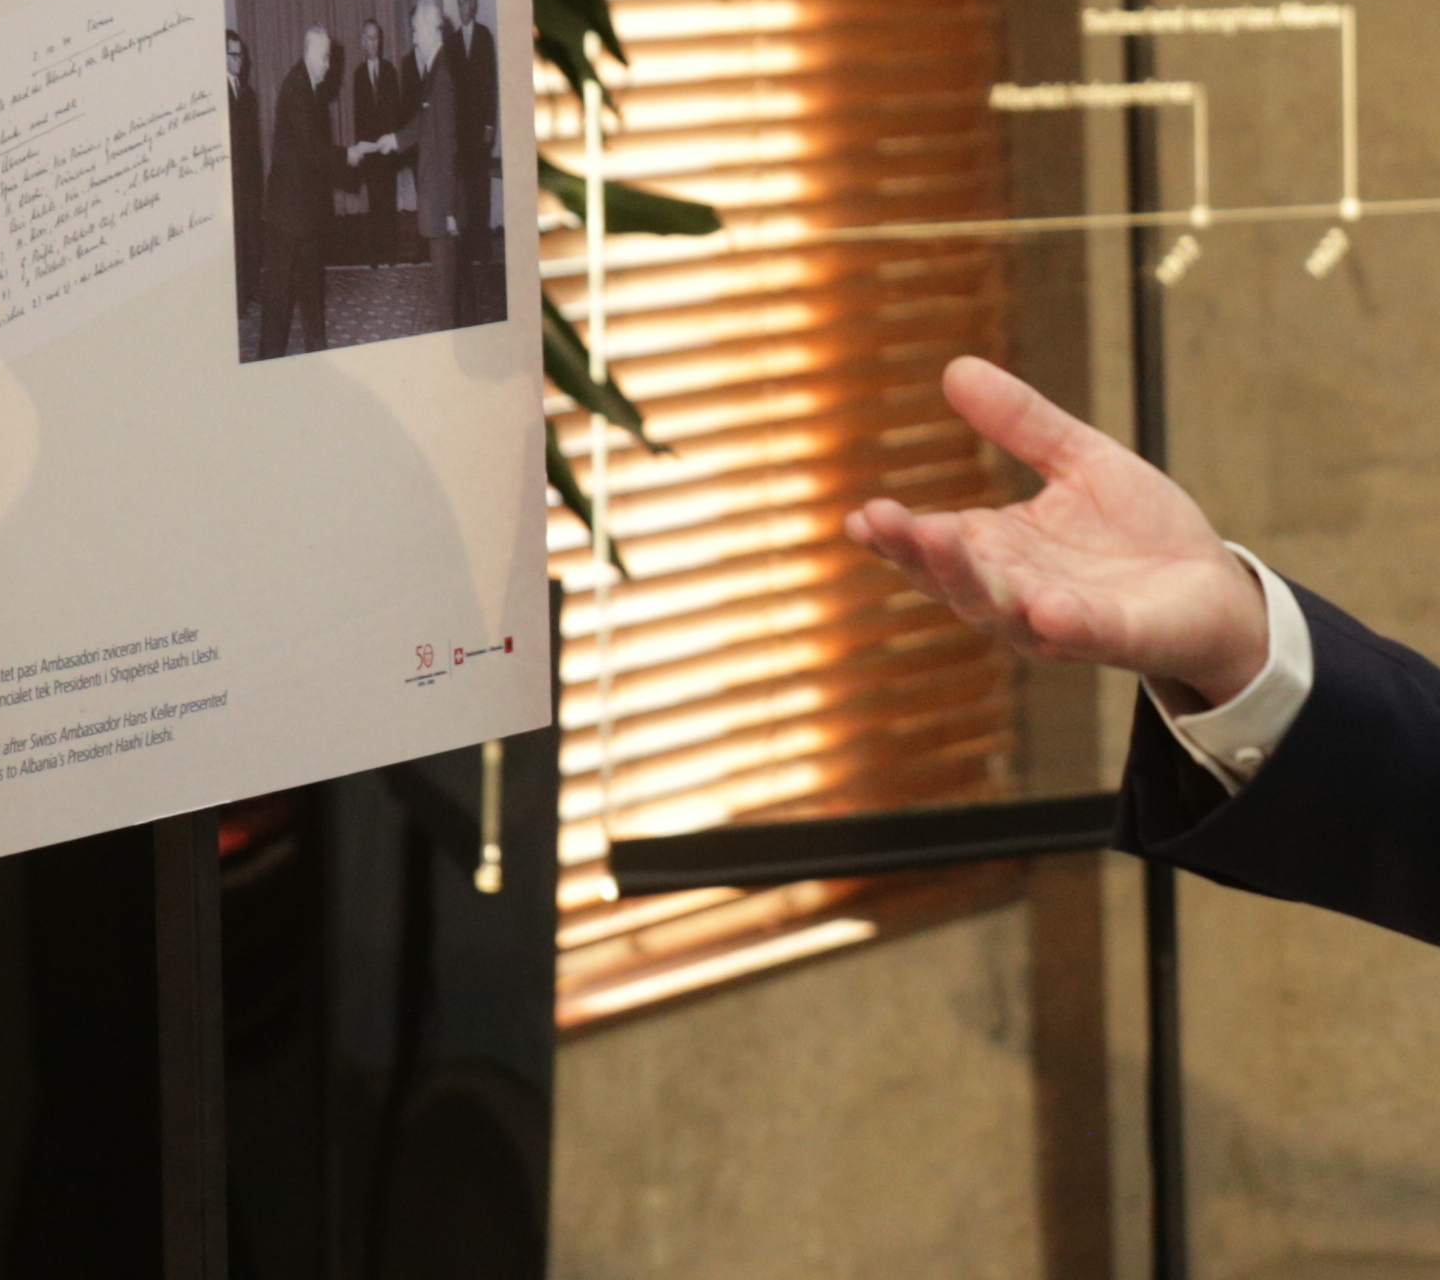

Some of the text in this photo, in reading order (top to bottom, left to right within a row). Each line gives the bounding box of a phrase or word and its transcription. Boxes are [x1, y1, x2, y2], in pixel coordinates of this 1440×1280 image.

[17, 662, 38, 683] pasi
[40, 648, 101, 674] Ambasadori
[102, 640, 142, 662] zviceran
[144, 634, 170, 652] Hans
[171, 626, 199, 647] Keller
[35, 681, 52, 701] tek
[53, 669, 103, 696] Presidenti
[110, 664, 161, 686] Shqipërisë
[162, 651, 190, 671] Haxhi
[415, 642, 434, 671] 50
[2, 736, 28, 757] after
[29, 729, 58, 750] Swiss
[59, 715, 122, 742] Ambassador
[123, 710, 149, 728] Hans
[150, 701, 178, 722] Keller
[179, 689, 228, 719] presented
[6, 764, 18, 781] to
[19, 752, 65, 778] Albania's
[67, 737, 113, 766] President
[114, 732, 143, 753] Haxhi
